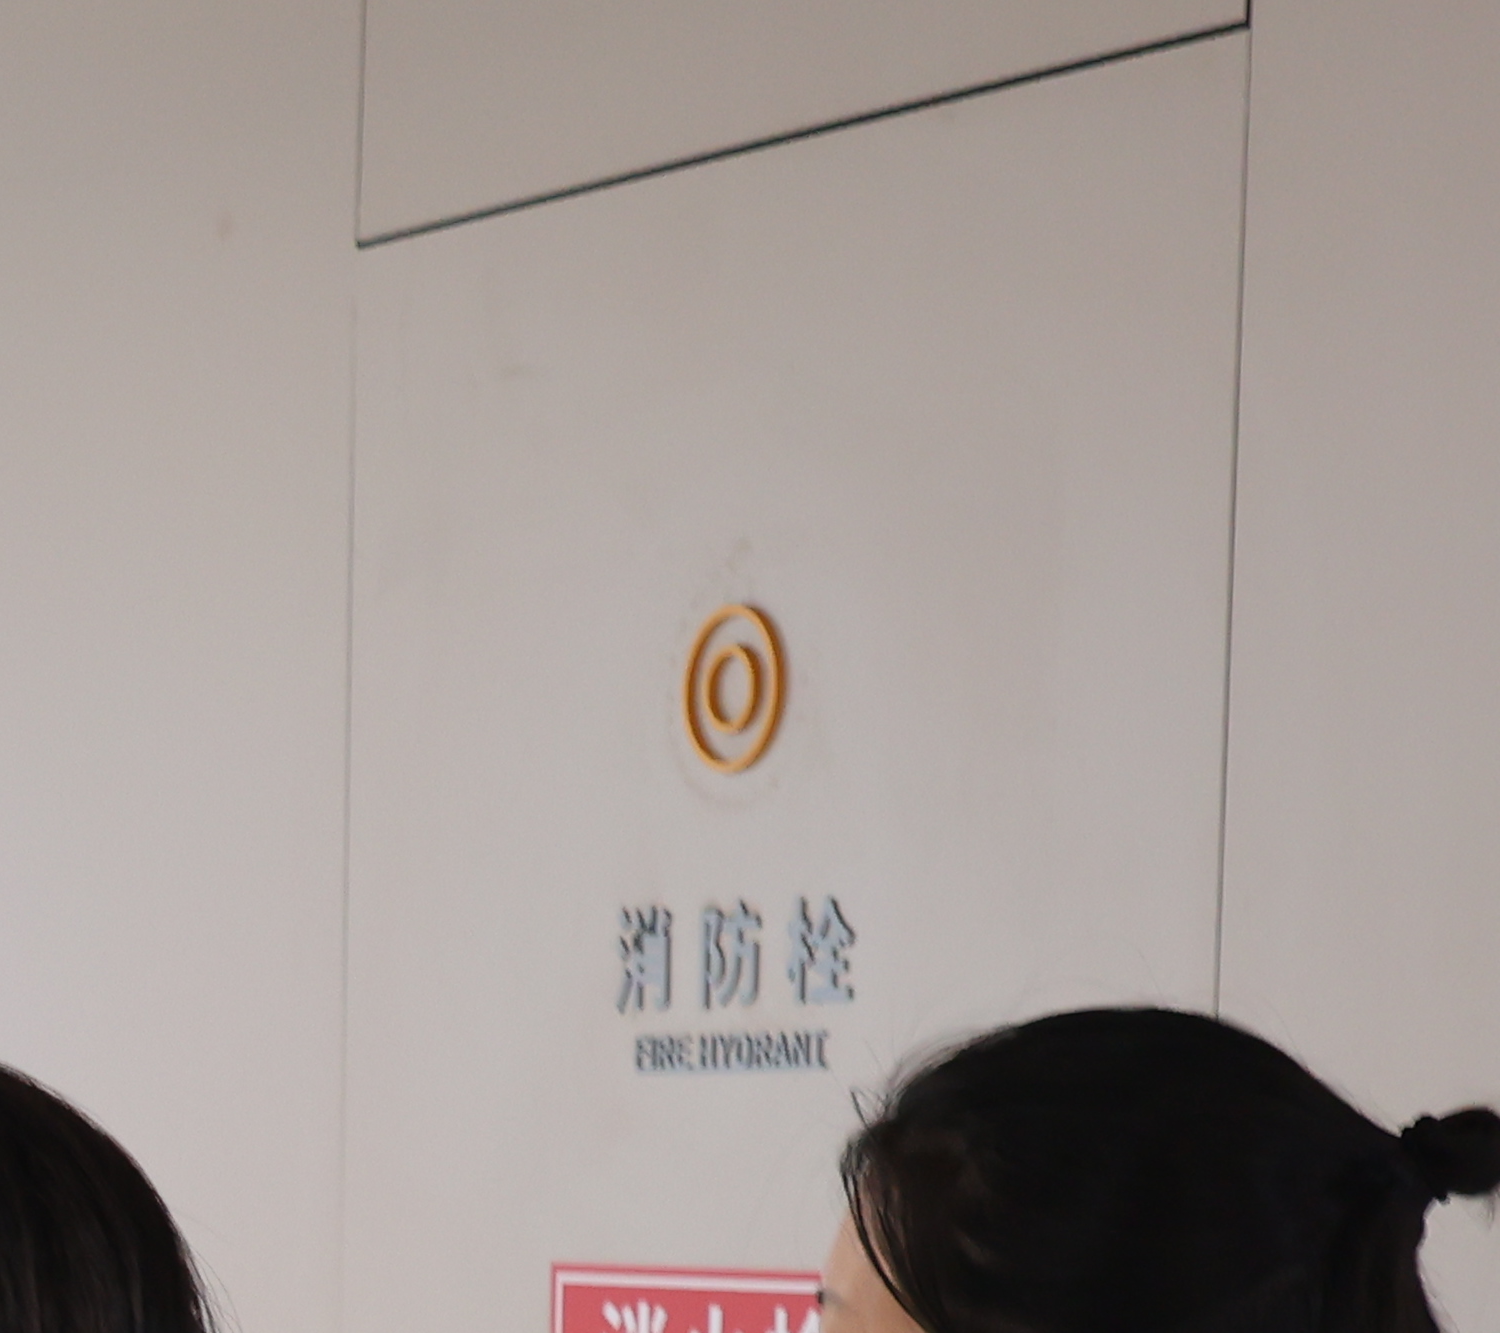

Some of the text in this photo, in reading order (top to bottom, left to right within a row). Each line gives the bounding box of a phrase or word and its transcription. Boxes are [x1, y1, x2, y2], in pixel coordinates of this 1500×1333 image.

[617, 895, 856, 1014] 消防栓
[635, 1029, 830, 1072] FIRE HYDRANT
